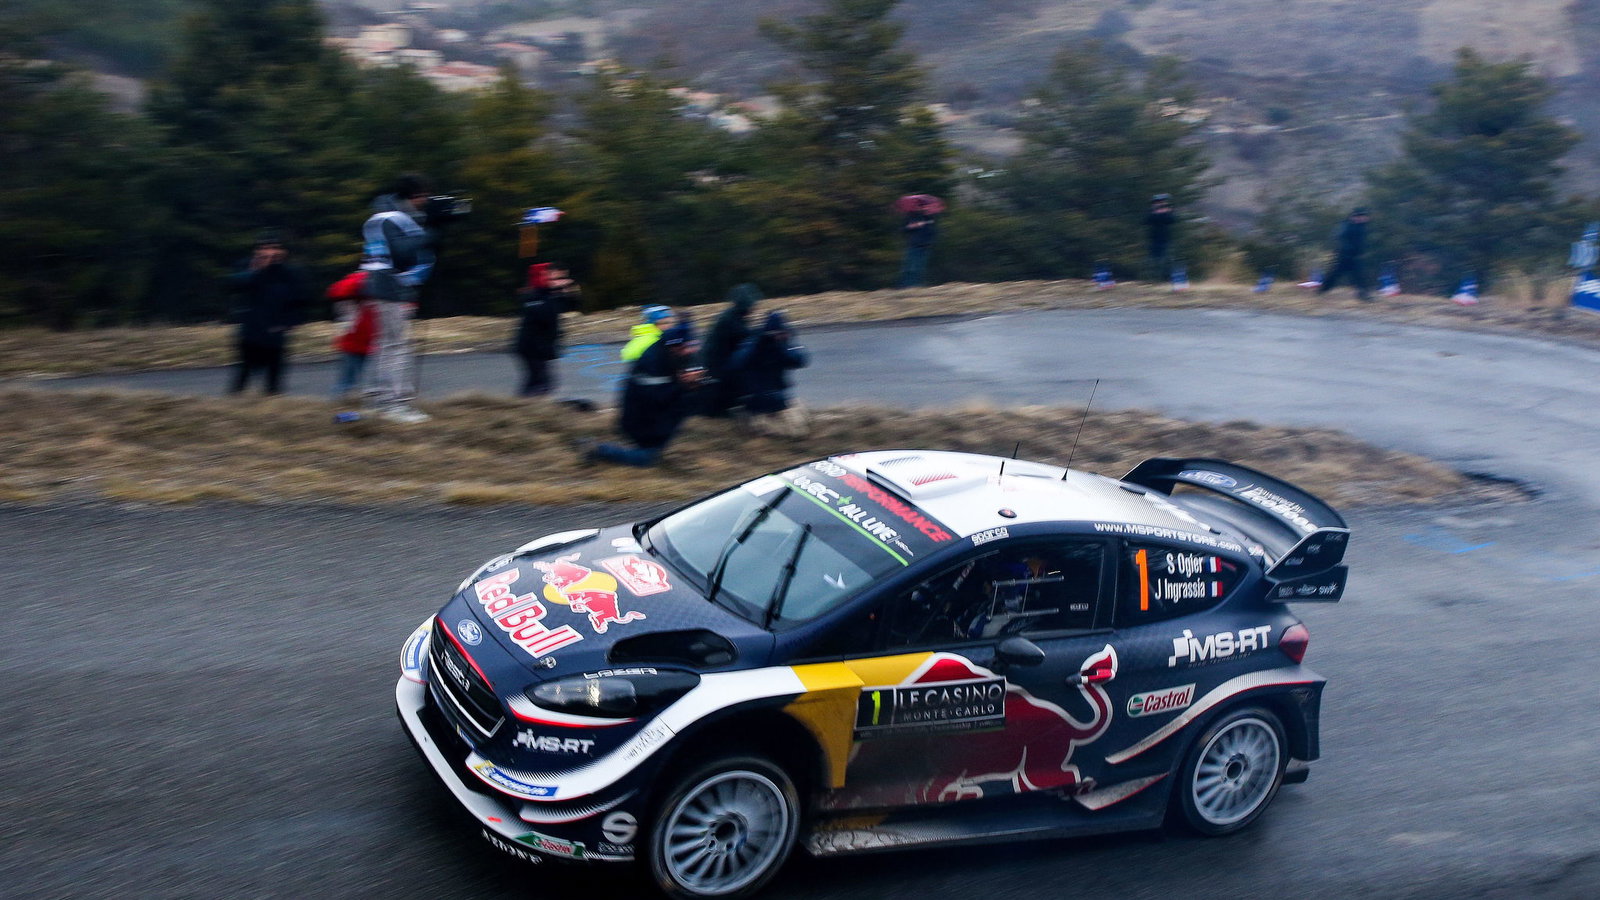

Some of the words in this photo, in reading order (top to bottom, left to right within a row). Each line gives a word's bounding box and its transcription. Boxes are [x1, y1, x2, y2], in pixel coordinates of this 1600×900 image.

[838, 503, 867, 523] ALL
[861, 516, 898, 542] LIVE
[971, 526, 1009, 546] sparco
[1094, 522, 1242, 553] www.MSPORTSTORE.com
[1166, 552, 1175, 575] S
[1177, 552, 1204, 578] Ogier
[1134, 549, 1149, 611] 1
[1154, 577, 1162, 600] J
[1164, 577, 1206, 603] Ingrassia
[871, 690, 881, 725] 1
[925, 683, 1003, 706] CASINO
[1143, 687, 1191, 714] Castrol
